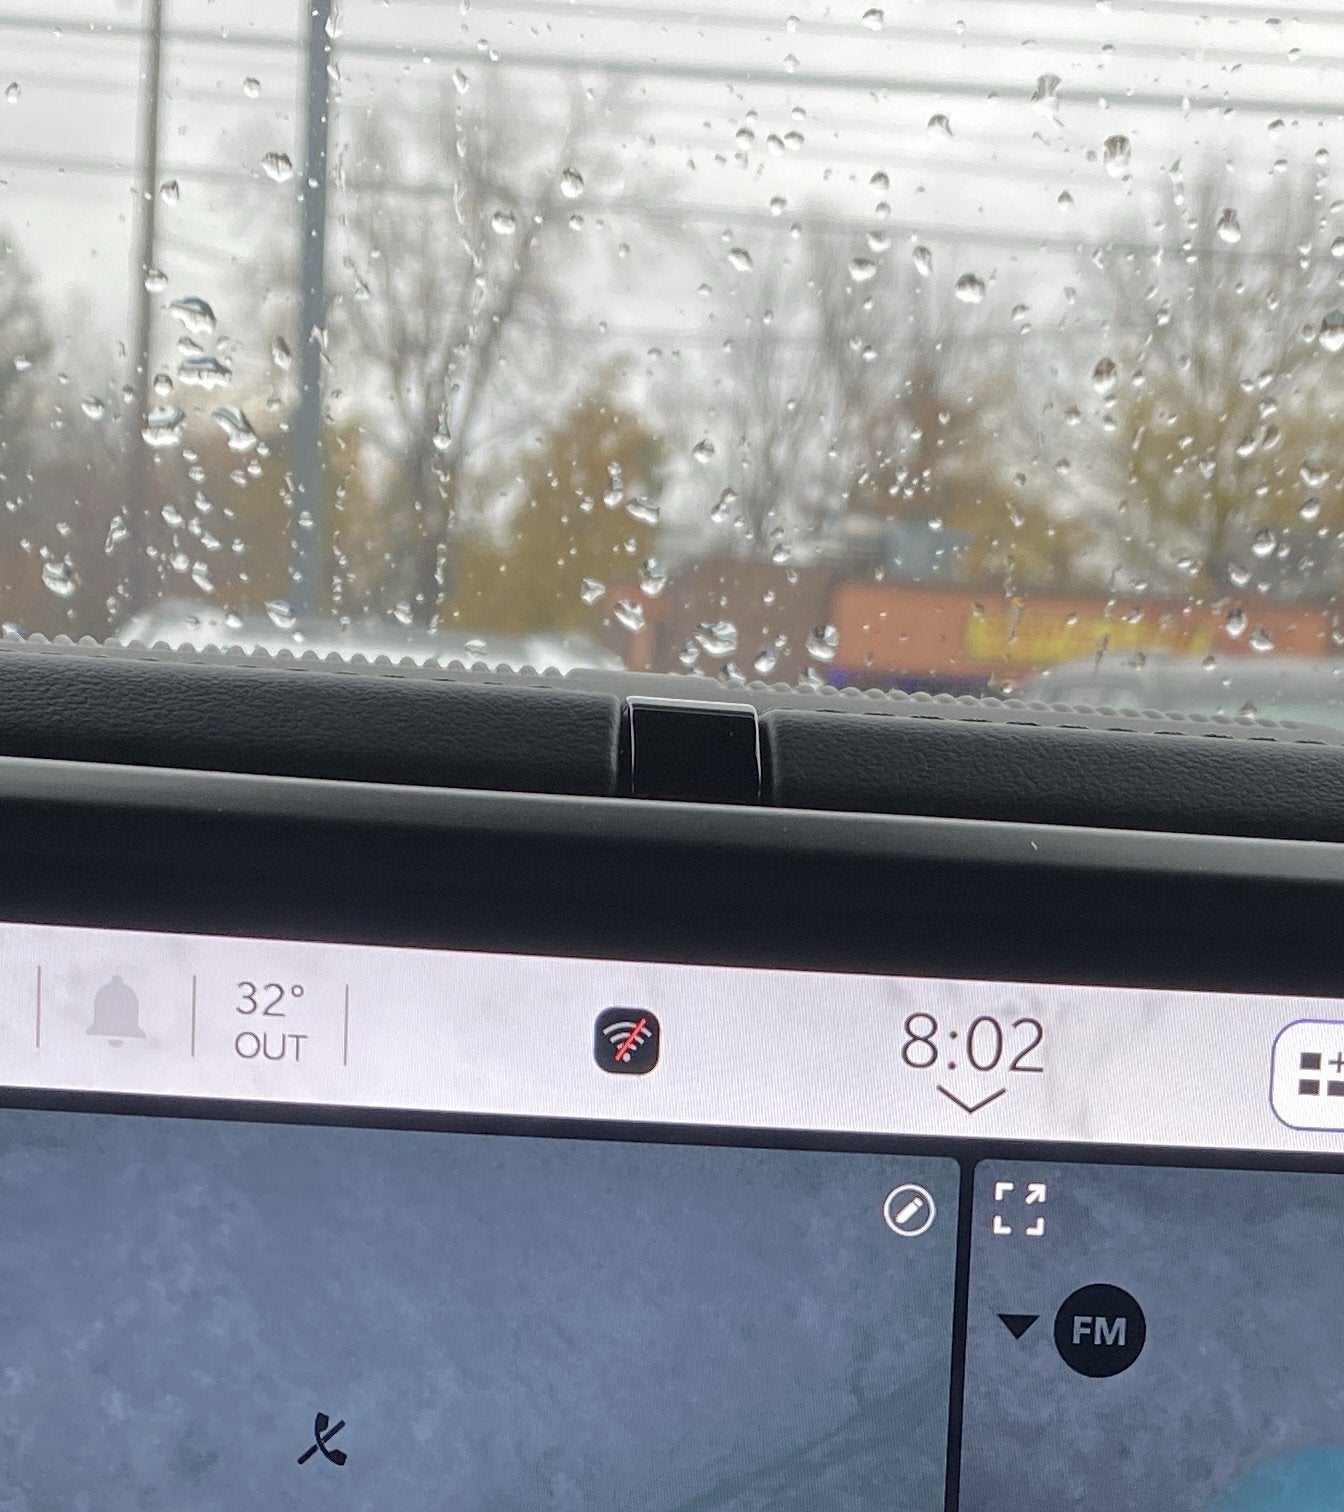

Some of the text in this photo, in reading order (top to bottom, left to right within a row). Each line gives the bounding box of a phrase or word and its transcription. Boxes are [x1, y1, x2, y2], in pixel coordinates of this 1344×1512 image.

[235, 981, 306, 1018] 32°
[233, 1032, 308, 1063] OUT
[900, 1011, 1045, 1074] 8:02
[1071, 1315, 1127, 1346] FM
